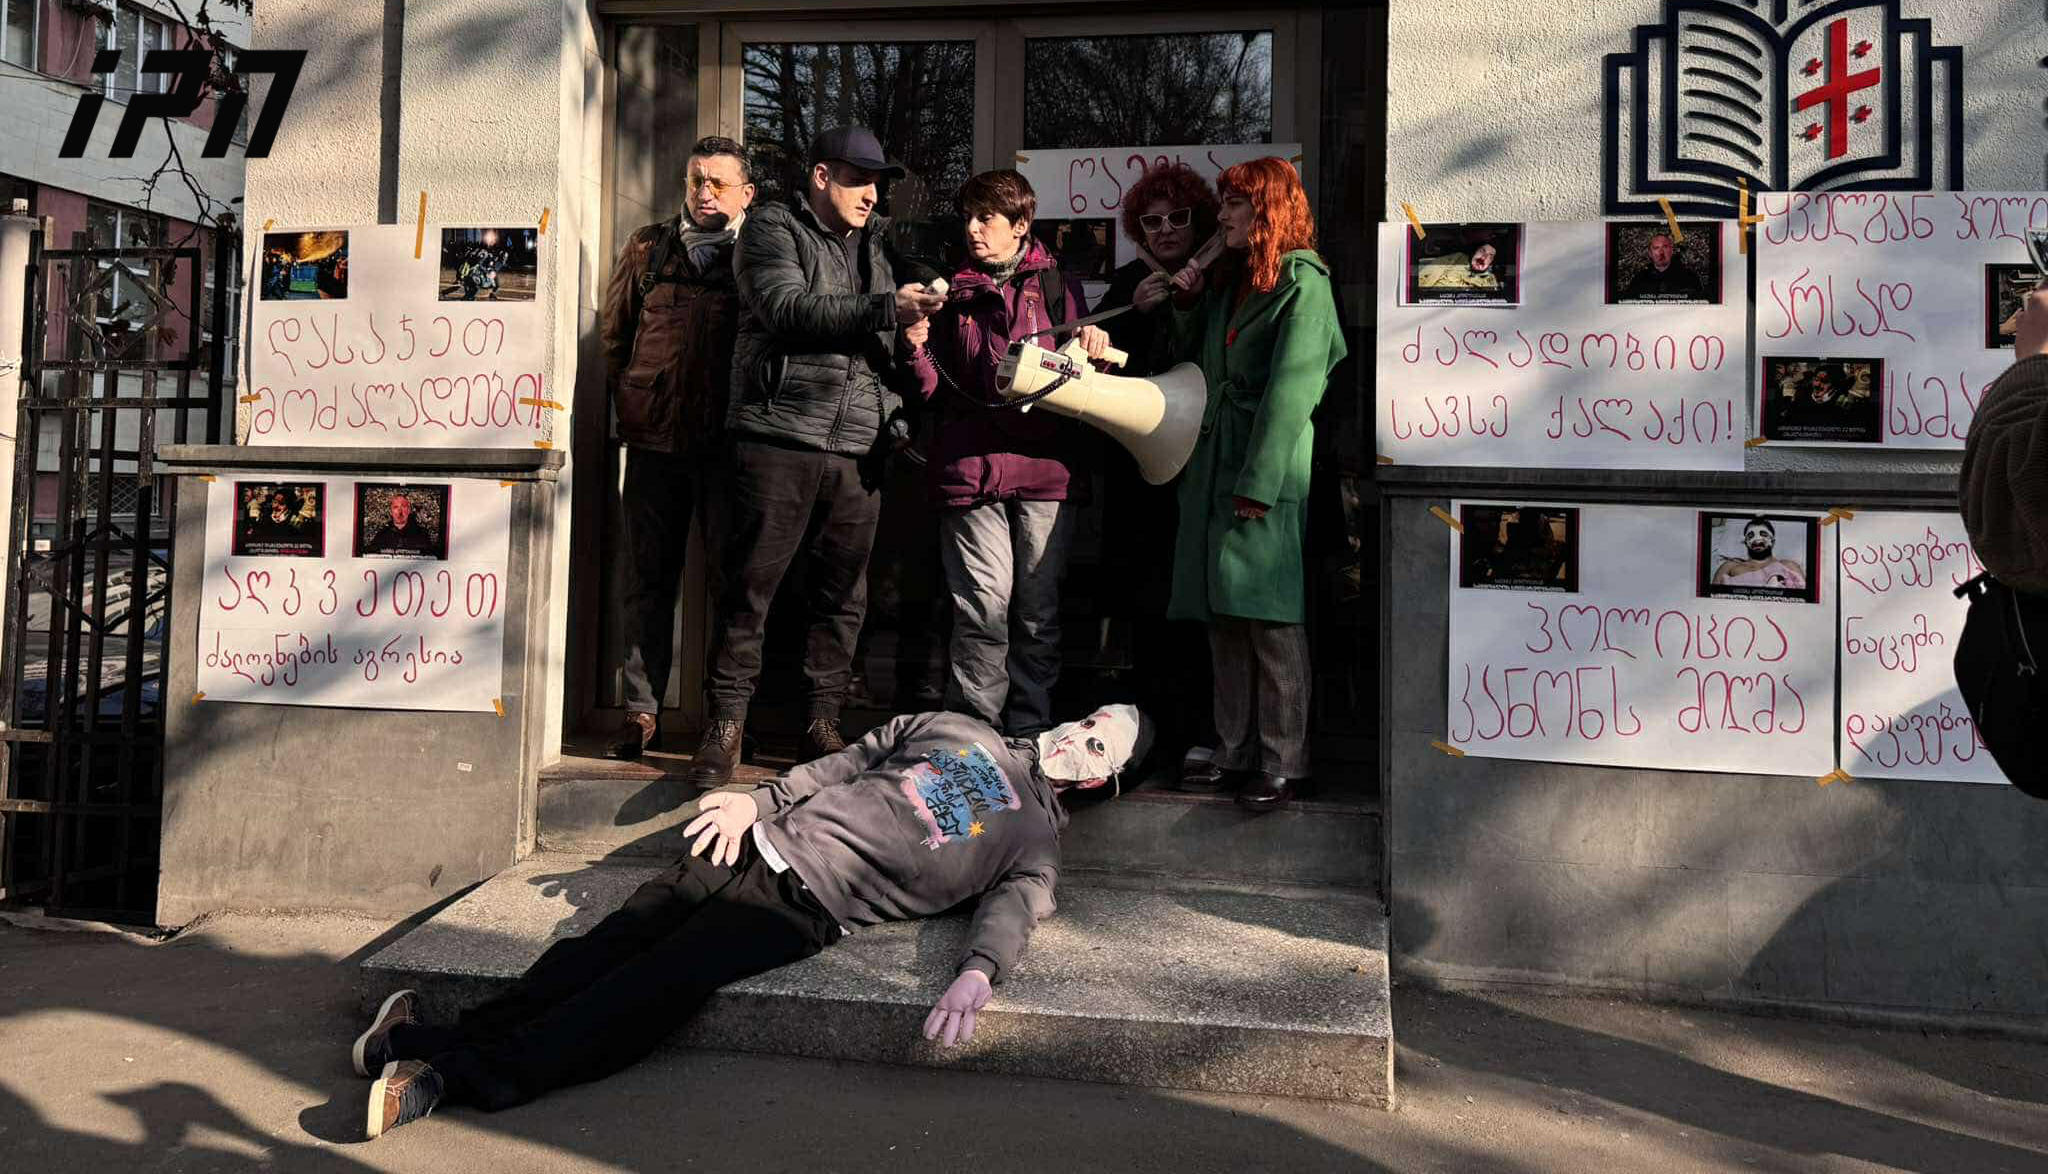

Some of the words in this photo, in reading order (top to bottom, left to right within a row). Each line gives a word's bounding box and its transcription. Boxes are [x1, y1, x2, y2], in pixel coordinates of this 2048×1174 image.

[1763, 192, 1935, 245] ყველგან
[1765, 267, 1916, 343] არსად
[268, 313, 505, 377] დასაჯეთ
[1402, 325, 1726, 371] ძალადობით
[1391, 394, 1511, 441] სავსე
[1546, 395, 1734, 445] ქალაქი!
[218, 565, 498, 619] აღკვეთეთ
[353, 634, 464, 683] აგრესია
[1526, 602, 1789, 662] პოლიცია
[1846, 613, 1944, 673] ნაცემი
[1452, 663, 1641, 743] კანონს
[1677, 666, 1806, 734] მიღმა
